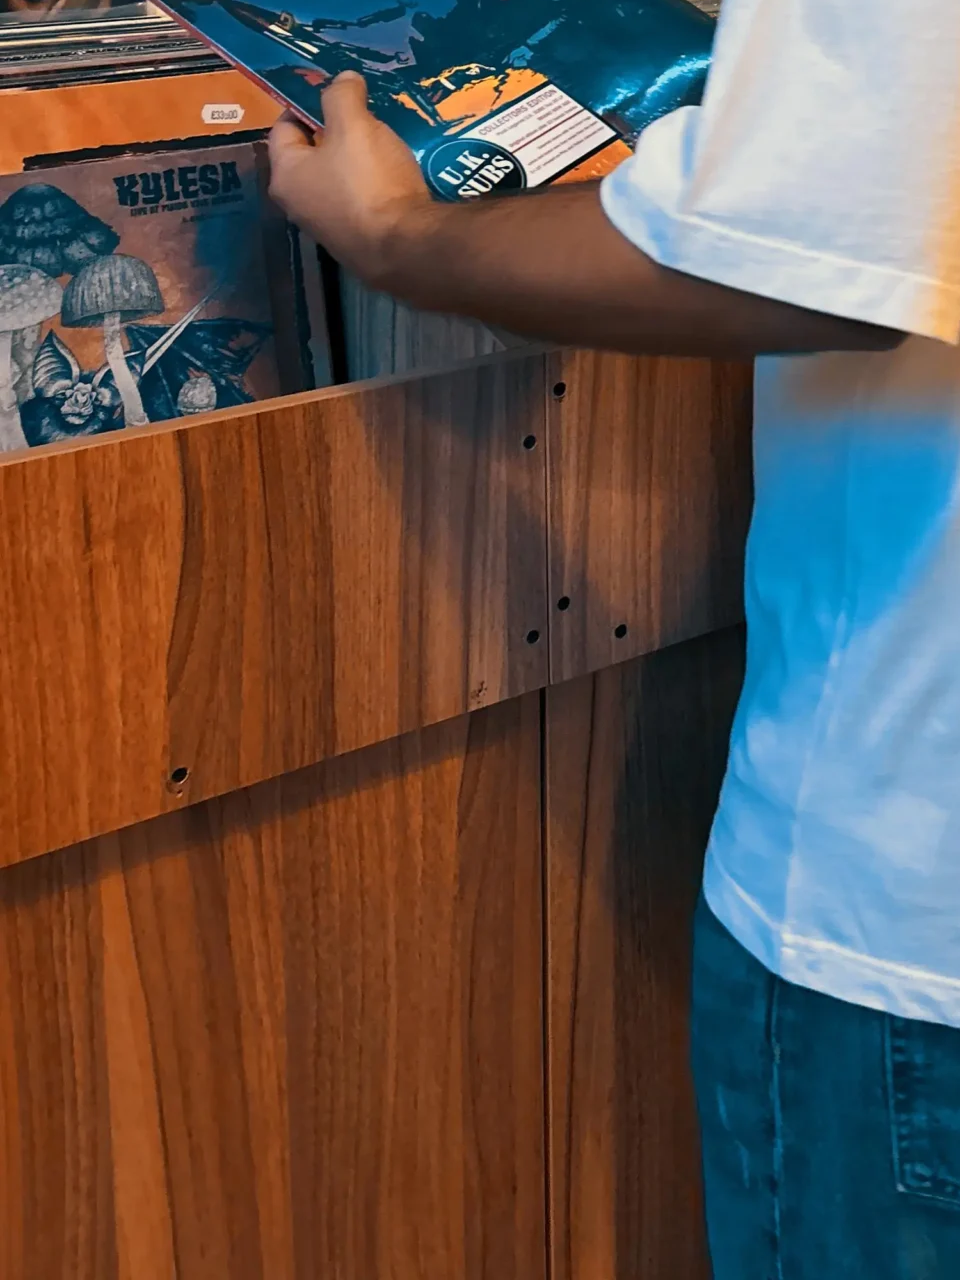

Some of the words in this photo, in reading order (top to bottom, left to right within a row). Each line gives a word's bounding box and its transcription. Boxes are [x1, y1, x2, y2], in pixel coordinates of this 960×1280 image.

[478, 100, 528, 136] COLLECTORS
[528, 88, 557, 108] EDITION
[113, 161, 241, 207] KYLESA
[438, 150, 490, 185] U.K.
[457, 155, 514, 197] SUBS
